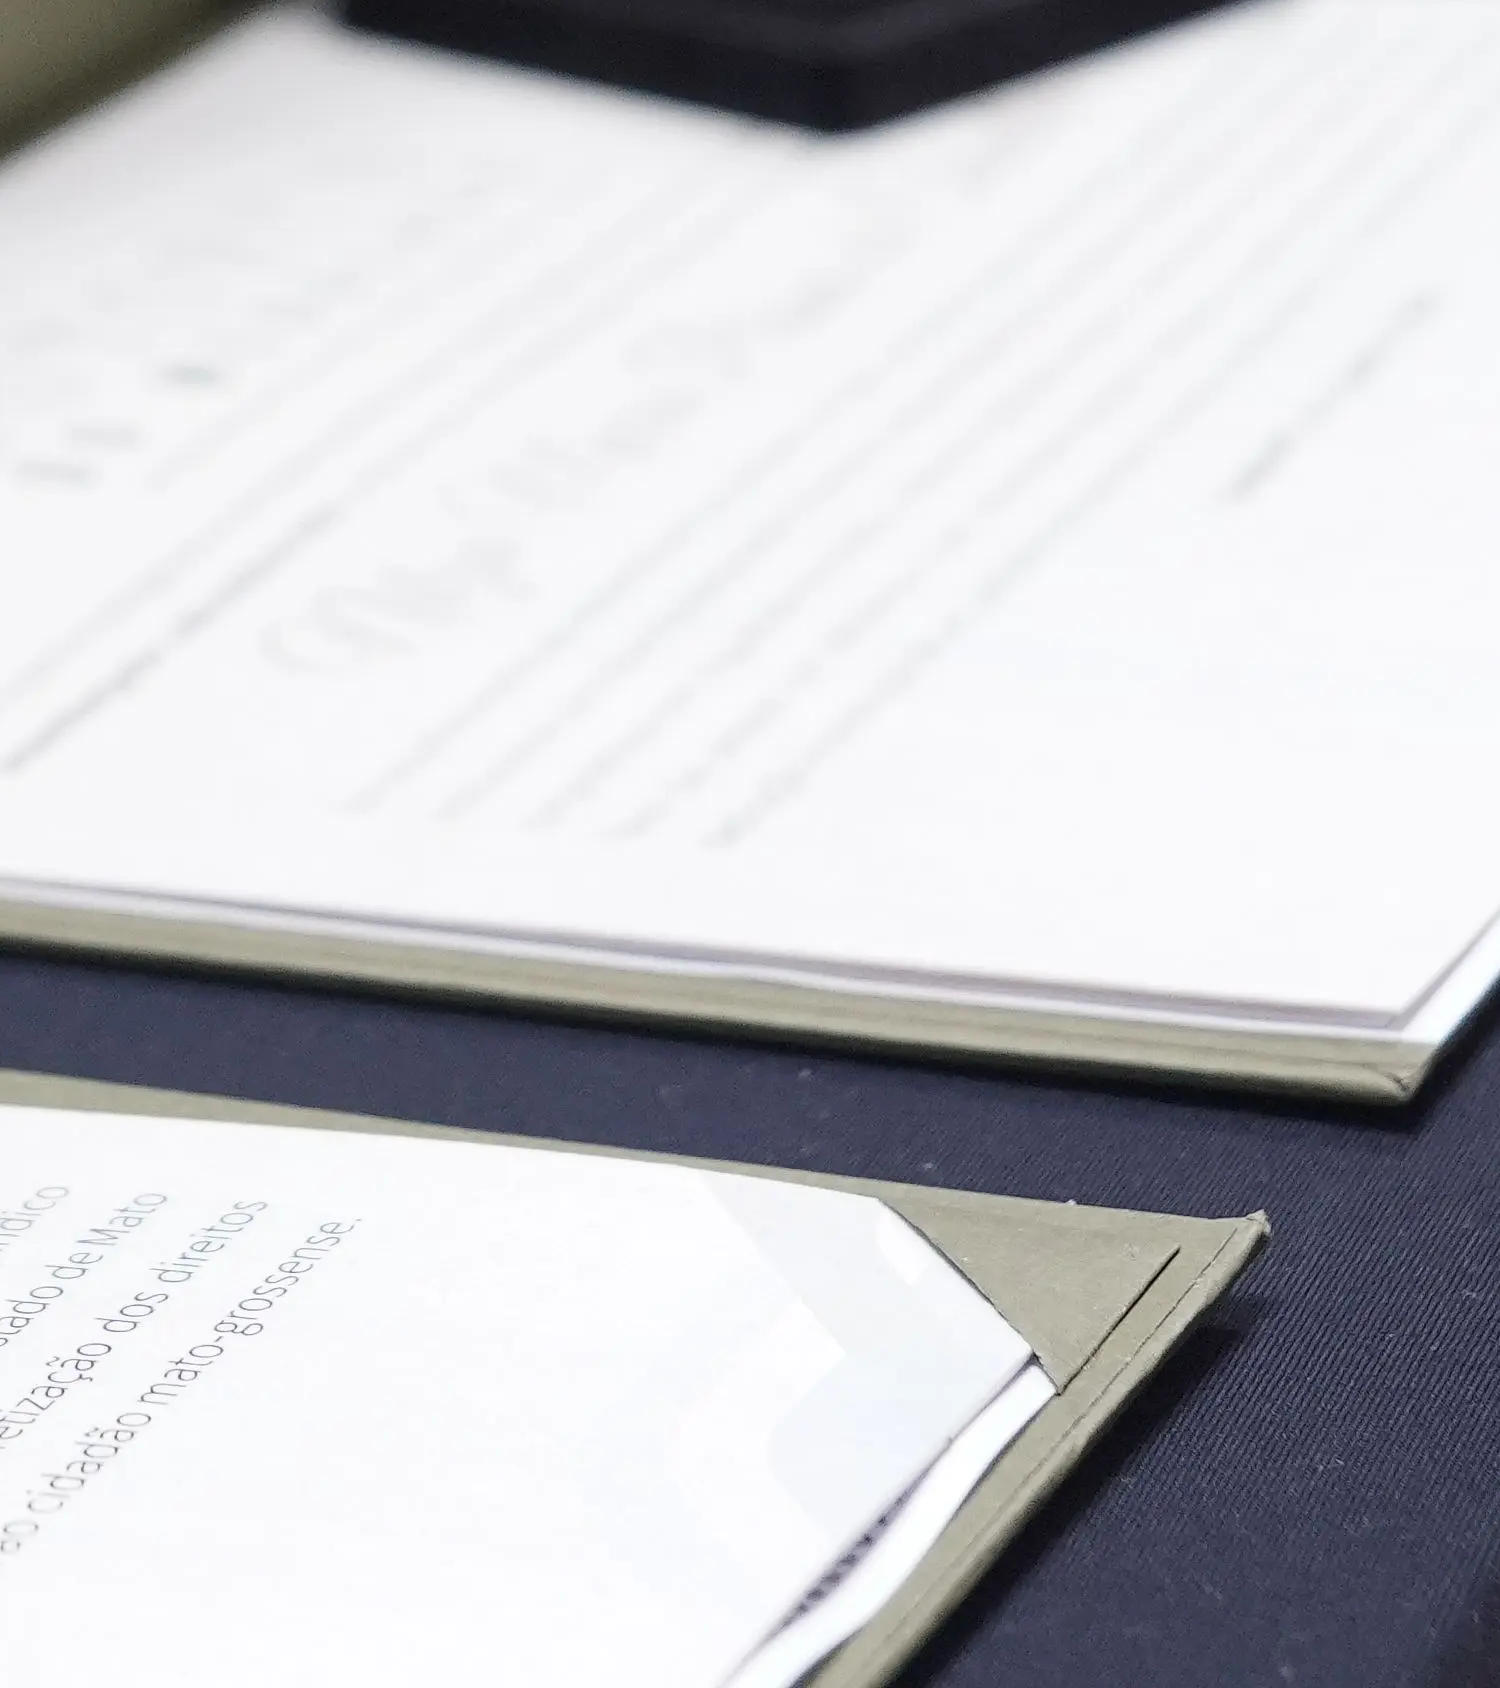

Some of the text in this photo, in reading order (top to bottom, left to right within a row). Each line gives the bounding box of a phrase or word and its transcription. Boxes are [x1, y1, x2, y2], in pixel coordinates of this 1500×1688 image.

[43, 1250, 104, 1281] de
[77, 1192, 168, 1247] Mato
[101, 1289, 169, 1334] dos
[150, 1199, 269, 1284] direitos
[26, 1412, 153, 1514] cidadão
[137, 1217, 363, 1405] mato-grossense.
